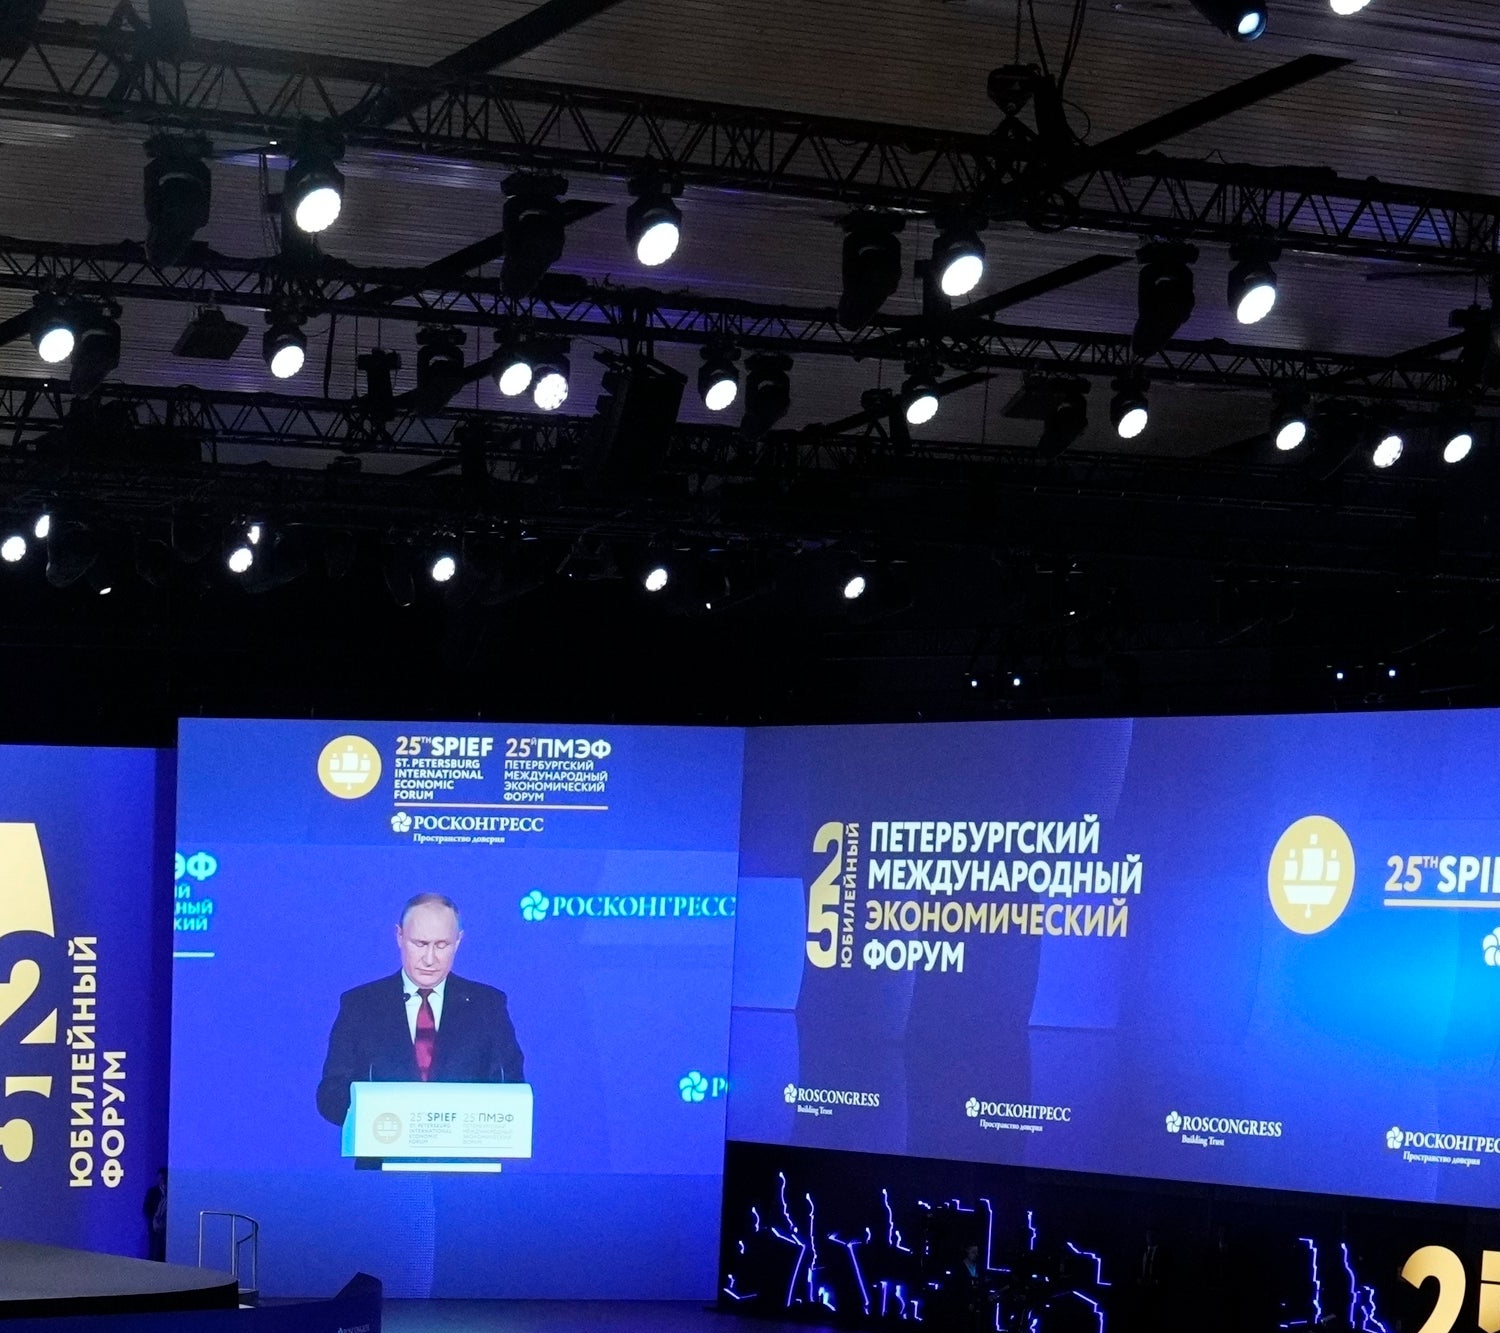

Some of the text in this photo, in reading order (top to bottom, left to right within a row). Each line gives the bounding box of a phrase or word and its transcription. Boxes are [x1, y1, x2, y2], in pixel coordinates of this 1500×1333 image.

[431, 737, 494, 757] SPIEF
[537, 739, 612, 760] ПМЭФ
[395, 758, 480, 769] ST. PETERSBURG
[504, 760, 594, 771] ПЕТЕРБУРГСКИЙ
[394, 769, 483, 780] INTERNATIONAL
[504, 770, 608, 782] МЕЖДУНАРОДНЫЙ
[394, 780, 455, 790] ECONOMIC
[394, 790, 434, 800] FORUM
[504, 781, 605, 793] ЭКОНОМИЧЕСКИЙ
[503, 792, 544, 802] ФОРУМ
[413, 815, 544, 832] РОСКОНГРЕСС
[870, 814, 1100, 855] ПЕТЕРБУРГСКИЙ
[867, 854, 1143, 896] МЕЖДУНАРОДНЫЙ
[840, 822, 861, 969] ЮБИЛЕЙНЫЙ
[551, 896, 736, 919] РОСКОНГРЕСС
[865, 898, 1128, 938] ЭКОНОМИЧЕСКИЙ
[862, 938, 965, 973] ФОРУМ
[67, 935, 97, 1188] ЮБИЛЕЙНЫЙ
[797, 1087, 880, 1107] ROSCONGRESS
[101, 1051, 127, 1189] ФОРУМ
[427, 1112, 457, 1122] SPIEF
[478, 1112, 514, 1123] ПМЭФ
[980, 1100, 1071, 1122] РОСКОНГРЕСС
[1182, 1116, 1282, 1137] ROSCONGRESS
